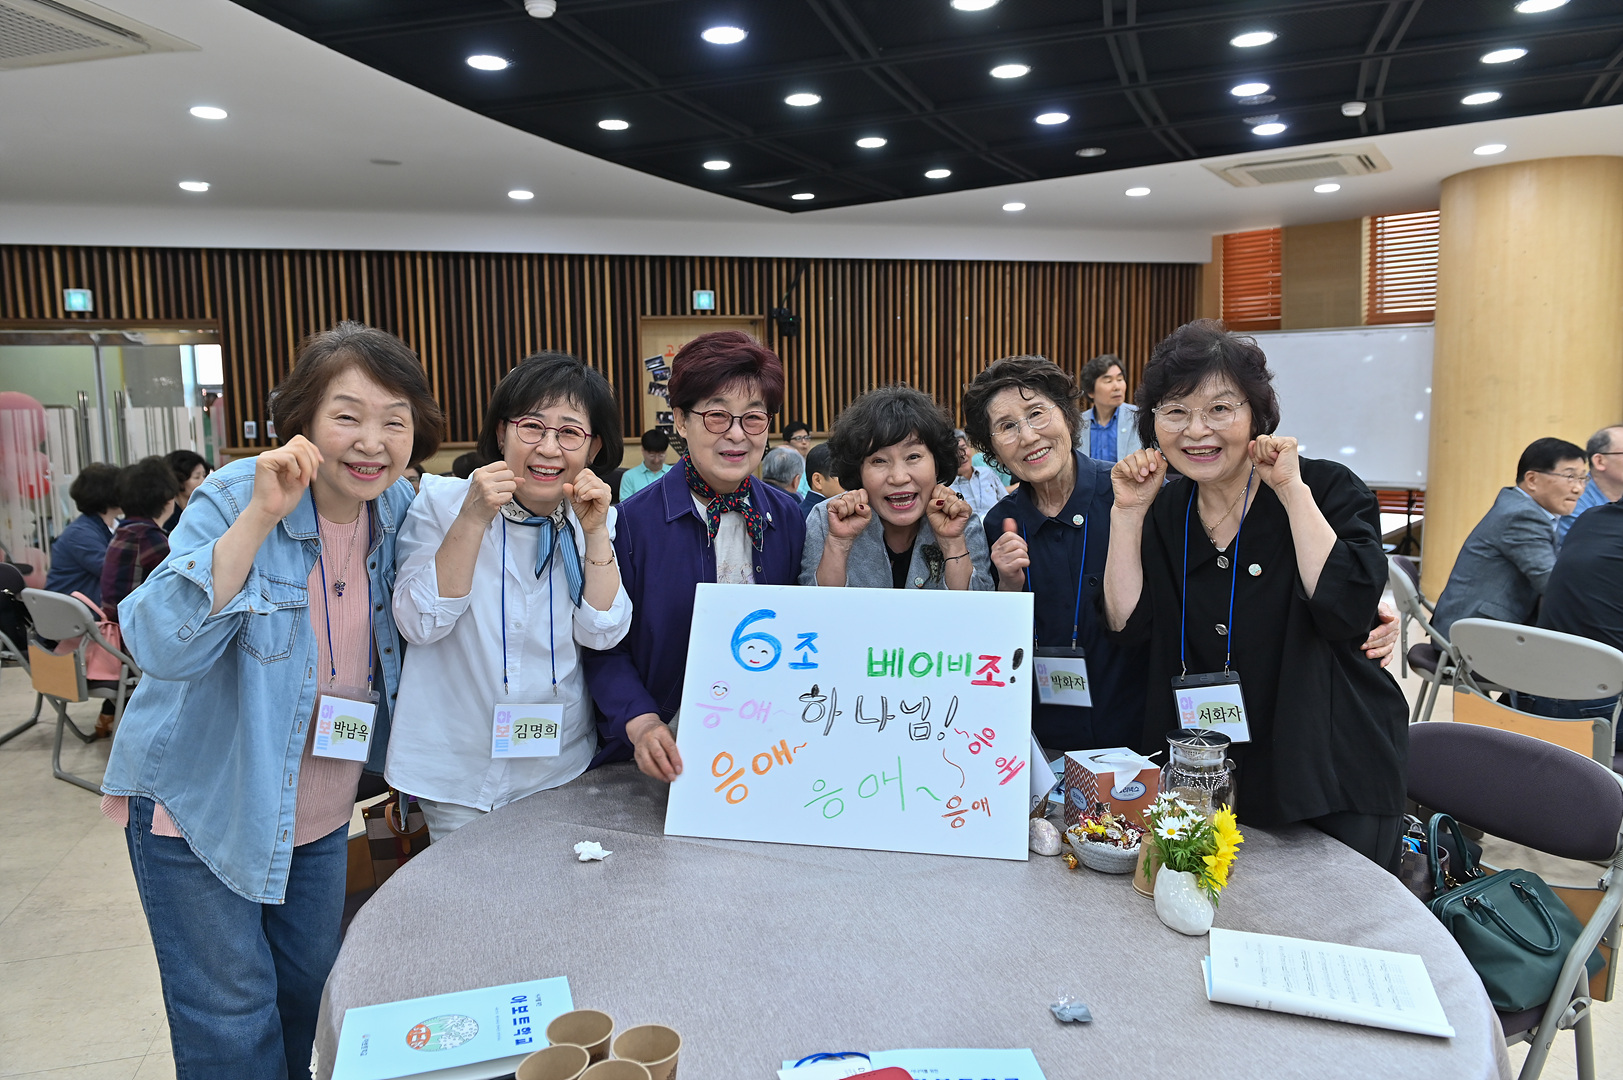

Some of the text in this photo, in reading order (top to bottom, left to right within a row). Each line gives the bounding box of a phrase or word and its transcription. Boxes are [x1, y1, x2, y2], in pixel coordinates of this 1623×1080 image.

[730, 608, 819, 672] 6조
[1050, 674, 1087, 690] 박화자
[798, 684, 959, 742] 하나님!
[1180, 696, 1197, 728] 아보
[1199, 705, 1243, 724] 서화자
[334, 720, 369, 742] 박남옥
[514, 723, 558, 739] 김명희
[510, 995, 533, 1046] 아보트학교
